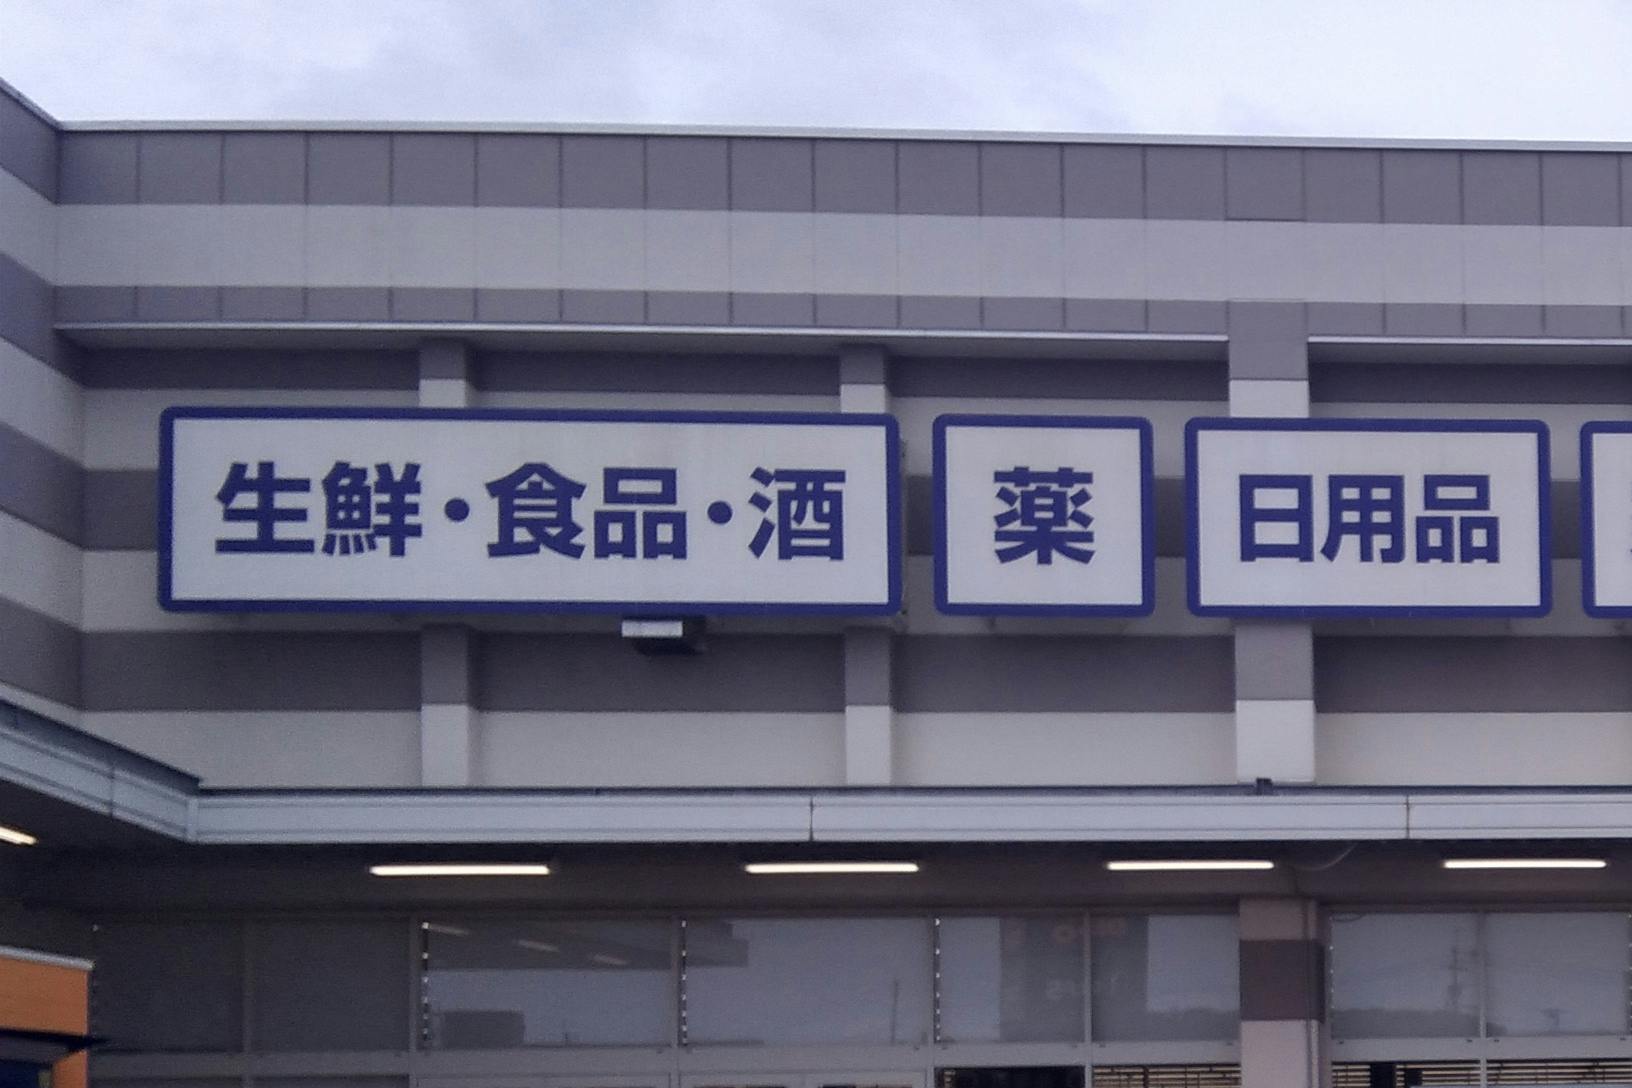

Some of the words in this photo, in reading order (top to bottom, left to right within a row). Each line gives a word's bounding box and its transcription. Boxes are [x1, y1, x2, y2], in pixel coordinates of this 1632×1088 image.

[215, 461, 846, 561] 生鮮・食品・酒
[994, 466, 1094, 565] 薬
[1239, 474, 1499, 563] 日用品
